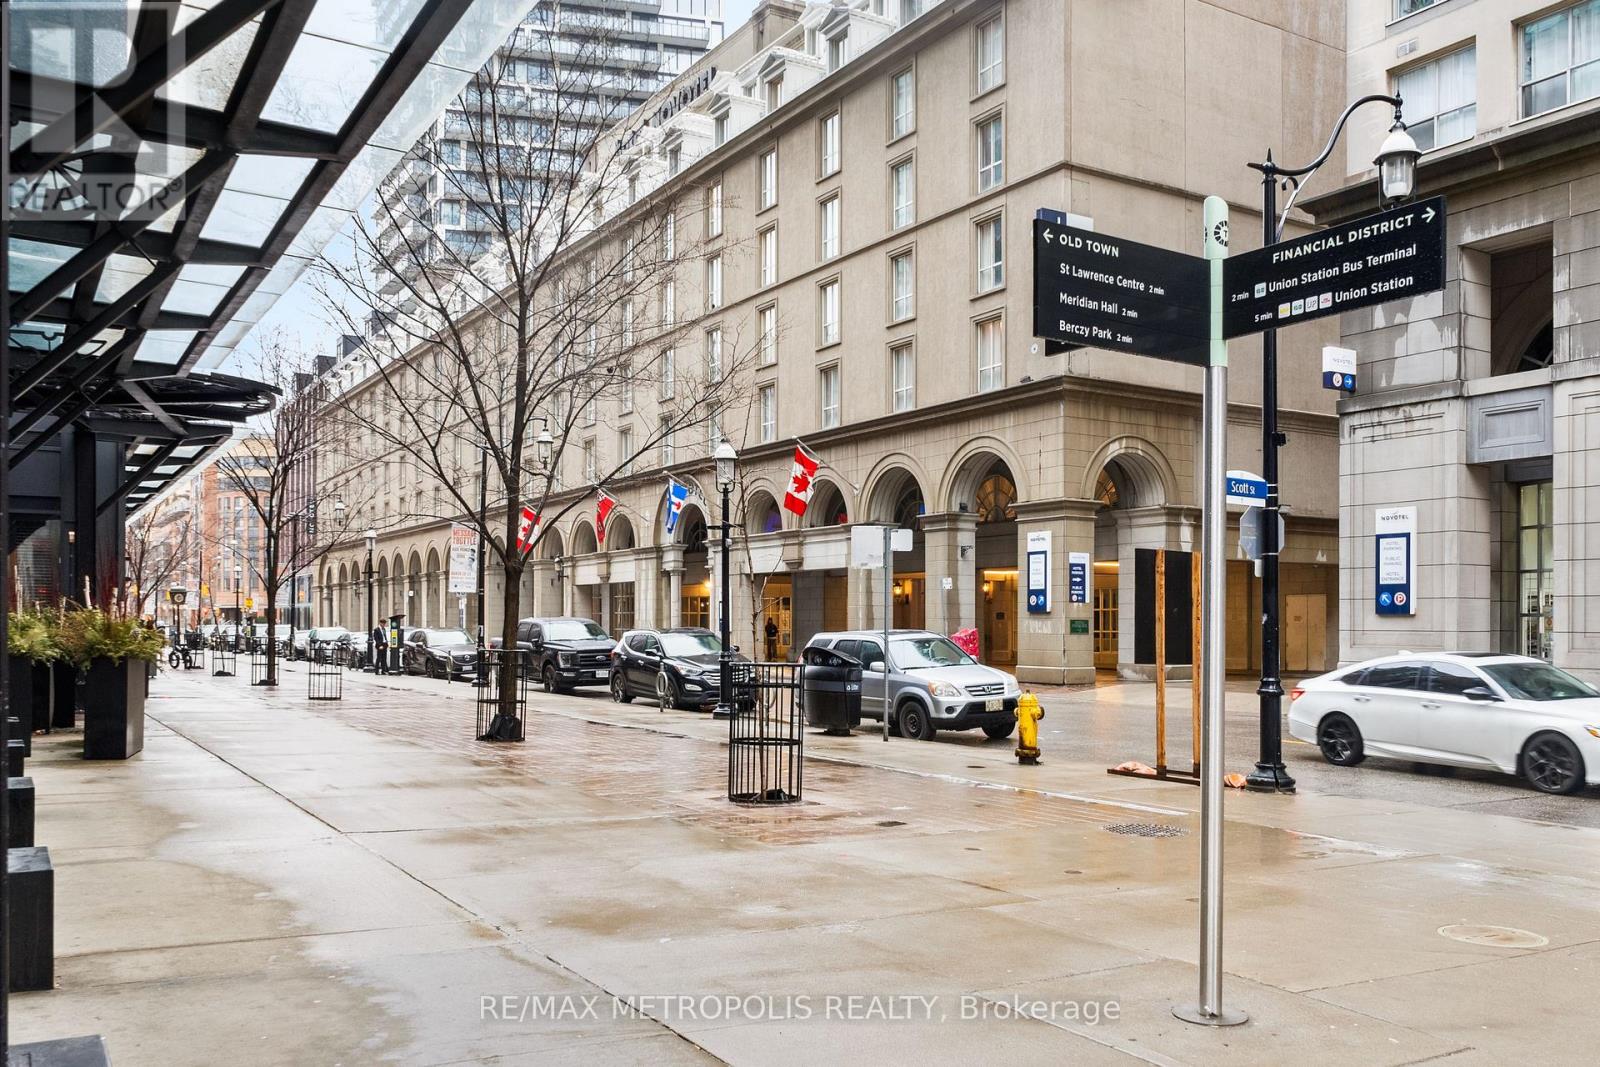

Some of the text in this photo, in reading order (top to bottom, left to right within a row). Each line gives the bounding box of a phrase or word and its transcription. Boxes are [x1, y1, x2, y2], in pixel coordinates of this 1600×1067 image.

[1060, 234, 1119, 258] OLD TOWN
[1272, 214, 1414, 264] FINANCIAL DISTRICT
[1060, 263, 1165, 295] St Lawrence Centre 2 min
[1232, 294, 1237, 302] 2
[1237, 291, 1249, 301] min
[1269, 277, 1298, 292] Union
[1301, 266, 1340, 284] Station
[1343, 260, 1363, 274] Bus
[1366, 243, 1417, 267] Terminal
[1060, 291, 1138, 318] Meridian Hall 2 min
[1254, 314, 1260, 322] 5
[1260, 312, 1273, 321] min
[1335, 287, 1368, 303] Union
[1371, 276, 1414, 294] Station
[1060, 320, 1133, 344] Berczy Park 2 min
[1231, 481, 1249, 494] Scott
